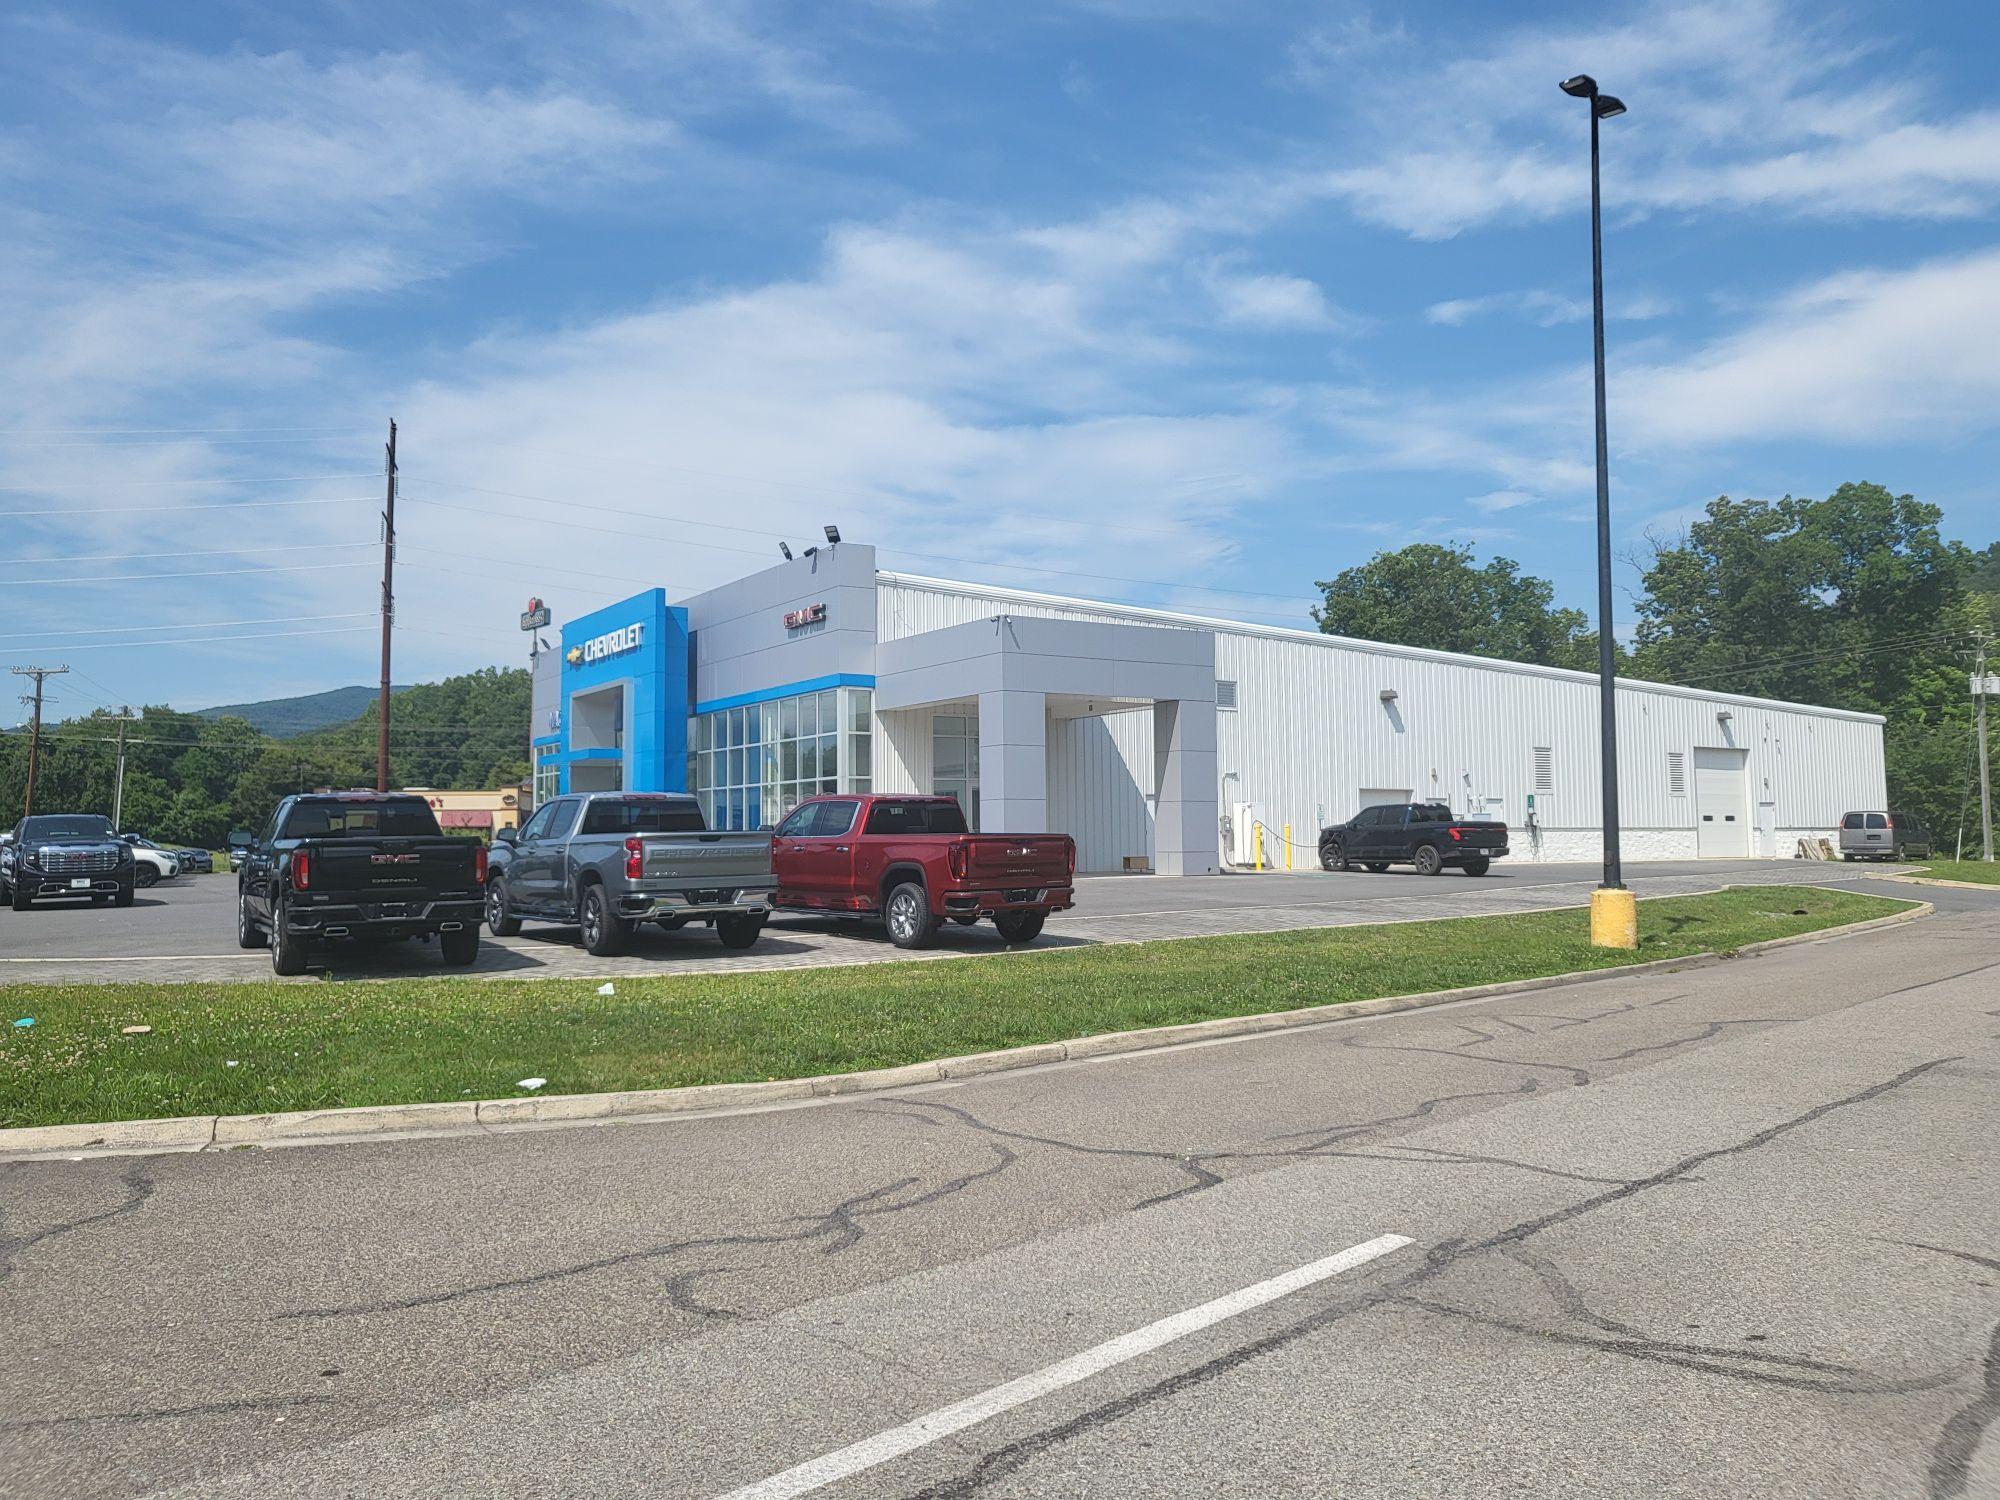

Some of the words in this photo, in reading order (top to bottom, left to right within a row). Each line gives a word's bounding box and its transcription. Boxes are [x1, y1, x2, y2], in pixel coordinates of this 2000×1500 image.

[783, 602, 827, 630] GMC
[583, 621, 646, 662] CHEVROLET
[370, 853, 420, 865] GMC
